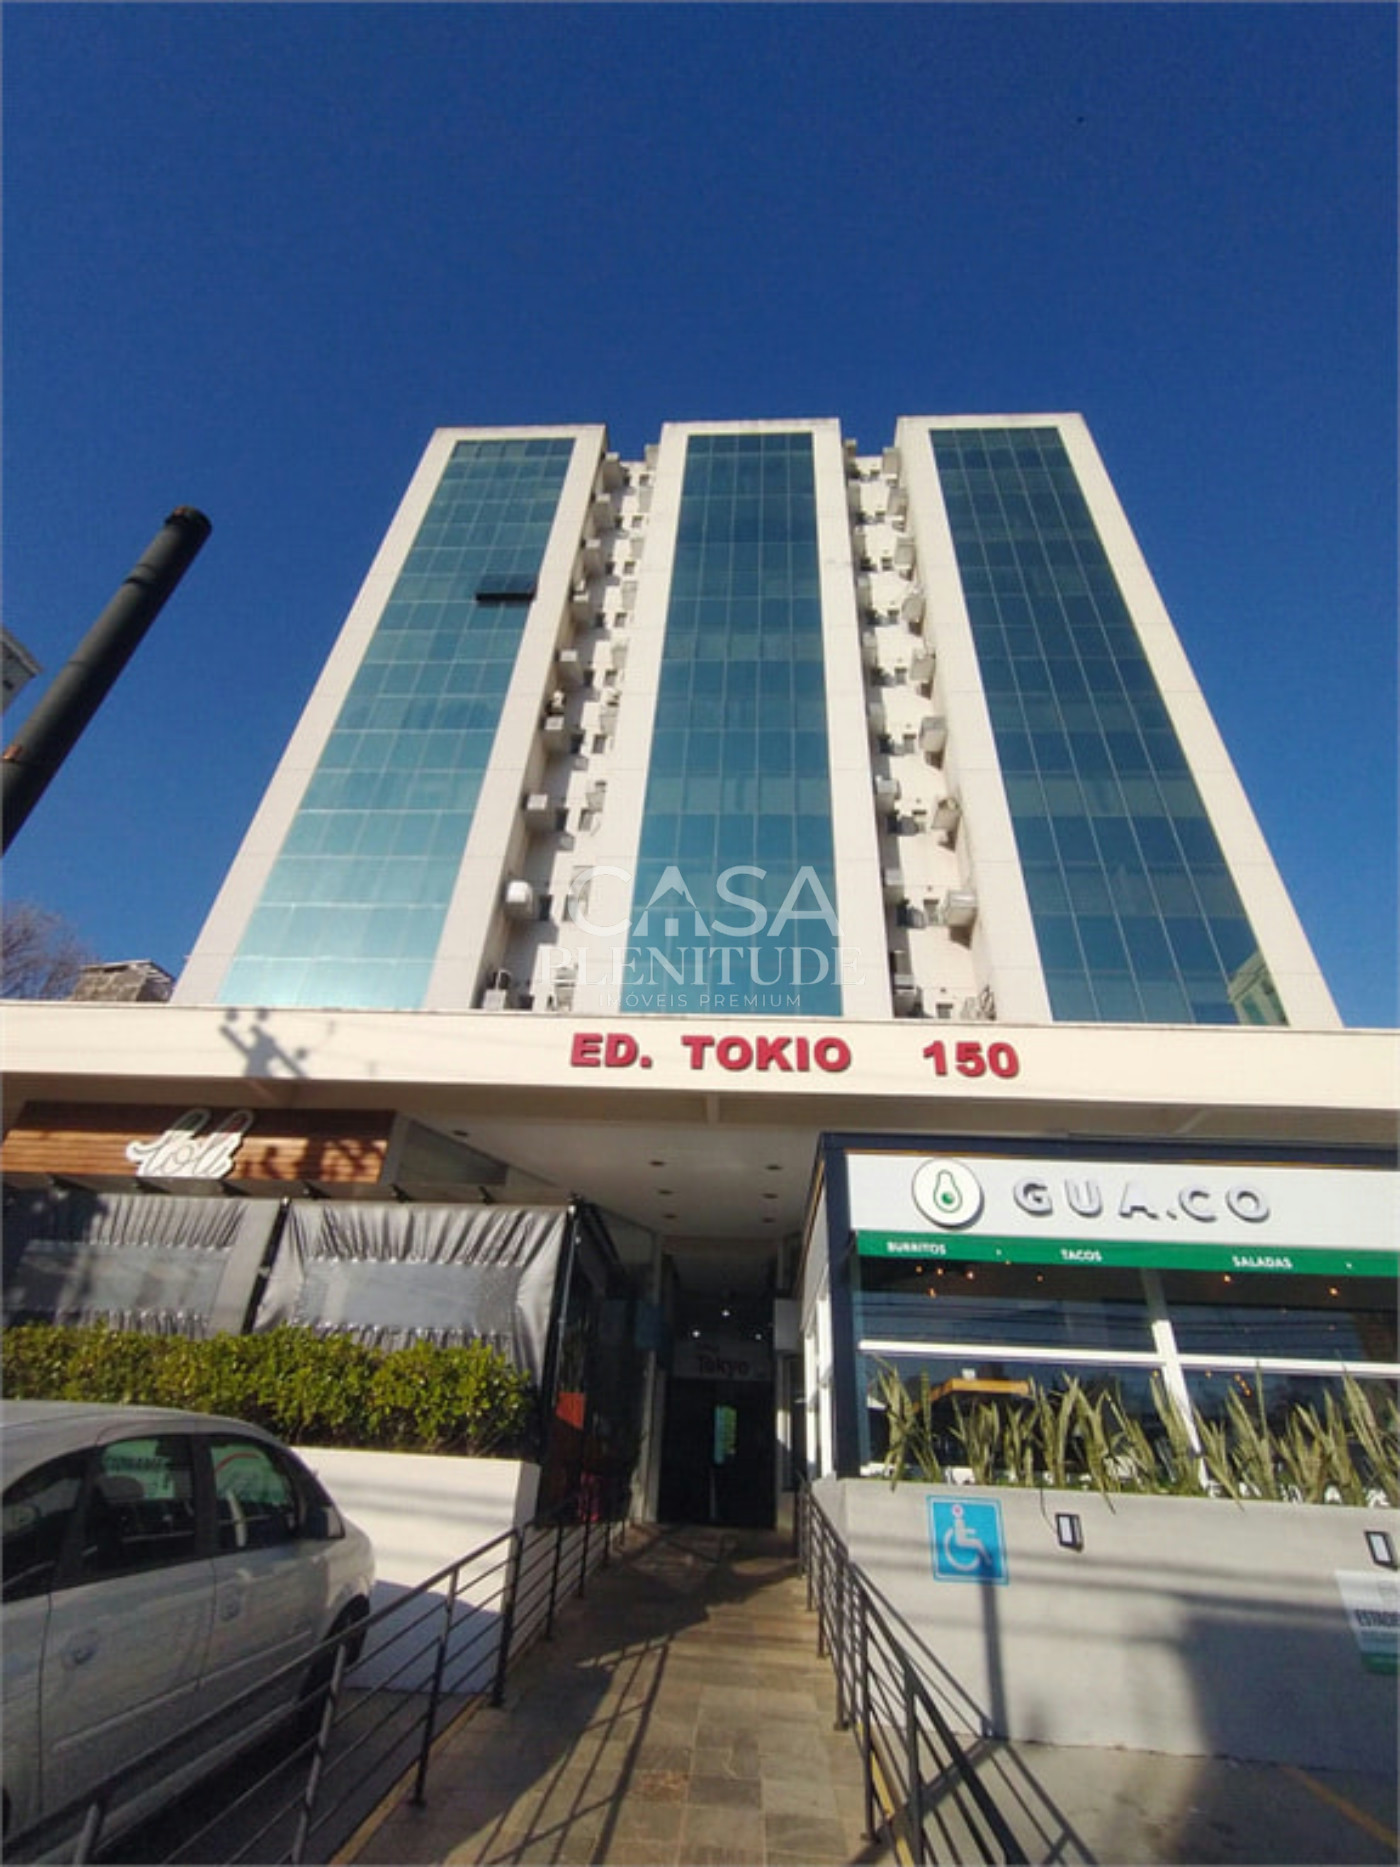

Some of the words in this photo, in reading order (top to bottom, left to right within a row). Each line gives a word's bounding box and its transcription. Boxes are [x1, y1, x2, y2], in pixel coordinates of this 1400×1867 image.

[570, 1033, 653, 1070] ED.
[681, 1035, 852, 1073] TOKIO
[922, 1040, 1021, 1079] 150
[1013, 1178, 1271, 1224] GUA.CO
[886, 1241, 947, 1256] BURRITOS
[1060, 1248, 1103, 1263] TACOS
[1232, 1255, 1294, 1270] SALADAS
